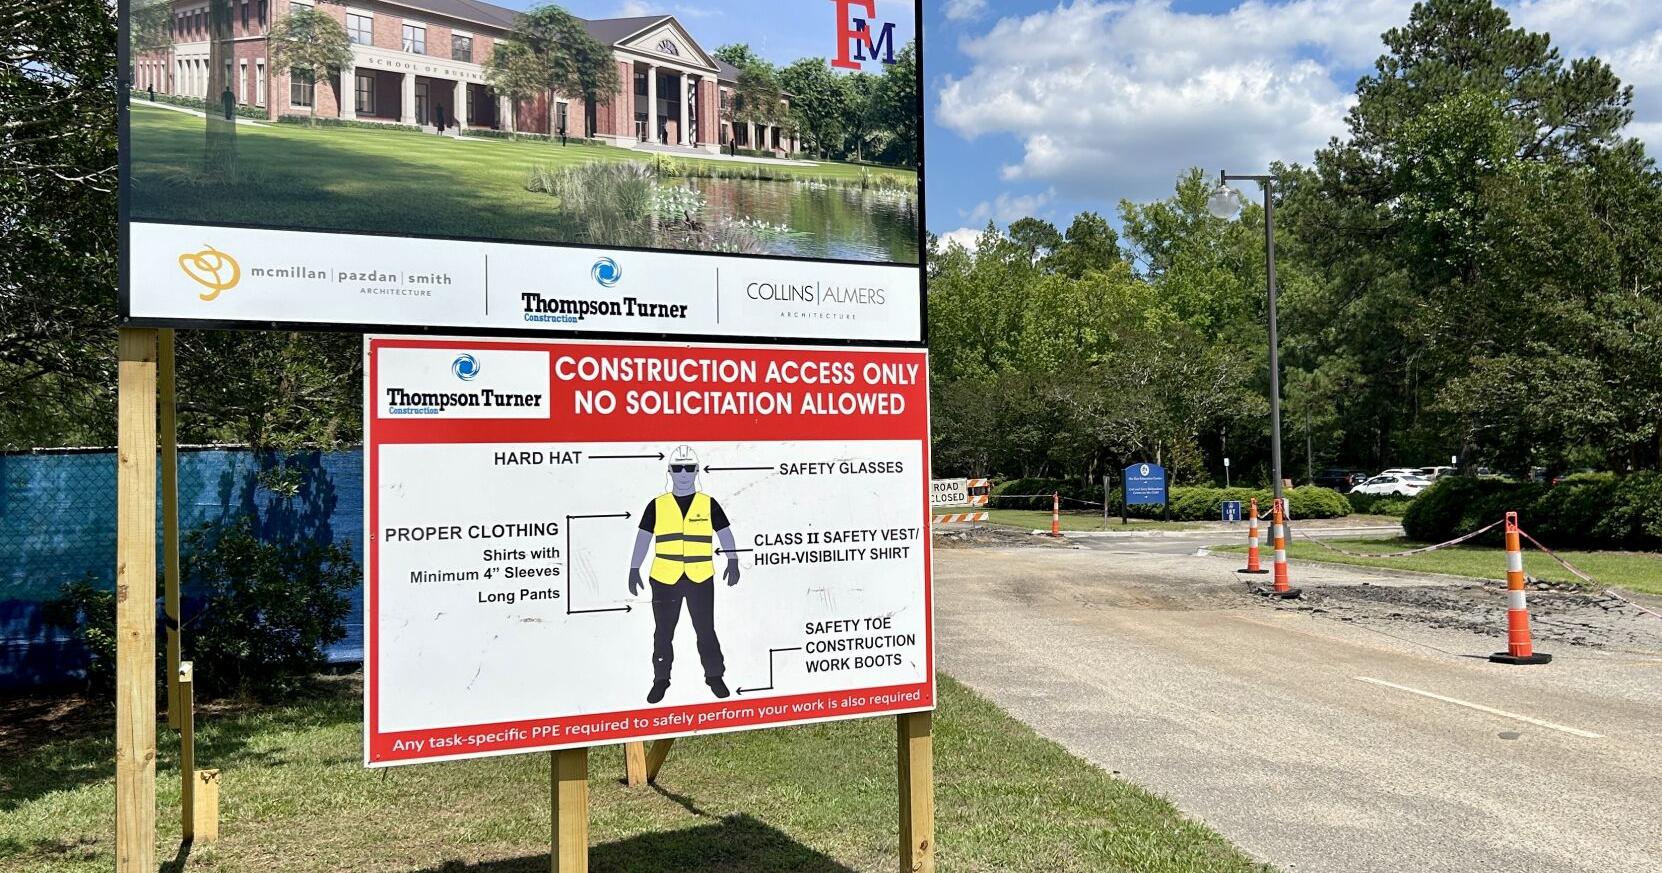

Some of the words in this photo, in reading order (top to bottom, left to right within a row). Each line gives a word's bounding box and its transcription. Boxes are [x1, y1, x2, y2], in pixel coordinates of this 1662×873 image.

[831, 0, 897, 71] FM
[369, 57, 418, 72] SCHOOL
[425, 65, 438, 73] OF
[252, 267, 326, 279] mcmillan
[339, 270, 396, 283] pazdan
[409, 274, 451, 284] smith
[360, 288, 431, 296] ARCHITECTURE
[747, 283, 813, 301] COLLINS
[823, 287, 885, 304] ALMERS
[522, 293, 621, 320] Thompson
[624, 298, 687, 318] Turner
[522, 312, 579, 324] Construction
[555, 356, 756, 382] CONSTRUCTION
[765, 361, 855, 384] ACCESS
[863, 363, 918, 384] ONLY
[387, 389, 479, 411] Thompson
[482, 390, 541, 406] Turner
[575, 390, 616, 414] NO
[626, 391, 792, 414] SOLICITATION
[801, 393, 905, 415] ALLOWED
[387, 405, 441, 416] Construction
[495, 452, 543, 465] HARD
[550, 451, 582, 464] HAT
[780, 463, 835, 475] SAFETY
[840, 462, 903, 474] GLASSES
[934, 482, 959, 492] ROAD
[386, 526, 462, 542] PROPER
[468, 523, 558, 538] CLOTHING
[754, 533, 802, 546] CLASS
[807, 533, 819, 544] II
[824, 530, 877, 543] SAFETY
[881, 528, 919, 540] VEST/
[483, 549, 525, 561] Shirts
[531, 547, 559, 559] with
[753, 549, 867, 566] HIGH-VISIBILITY
[870, 547, 909, 560] SHIRT
[411, 570, 478, 583] Minimum
[504, 565, 561, 578] Sleeves
[479, 592, 514, 604] Long
[521, 588, 560, 600] Pants
[806, 619, 860, 634] SAFETY
[864, 617, 891, 630] TOE
[805, 633, 916, 655] CONSTRUCTION
[806, 658, 850, 673] WORK
[855, 654, 901, 668] BOOTS
[393, 740, 424, 752] Any
[429, 728, 528, 749] task-specific
[533, 725, 560, 738] PPE
[565, 717, 630, 736] required
[633, 719, 648, 728] to
[653, 713, 694, 726] safely
[698, 708, 755, 723] perform
[758, 705, 789, 718] your
[792, 700, 824, 712] work
[828, 699, 837, 708] is
[841, 696, 865, 707] also
[870, 689, 920, 705] required
